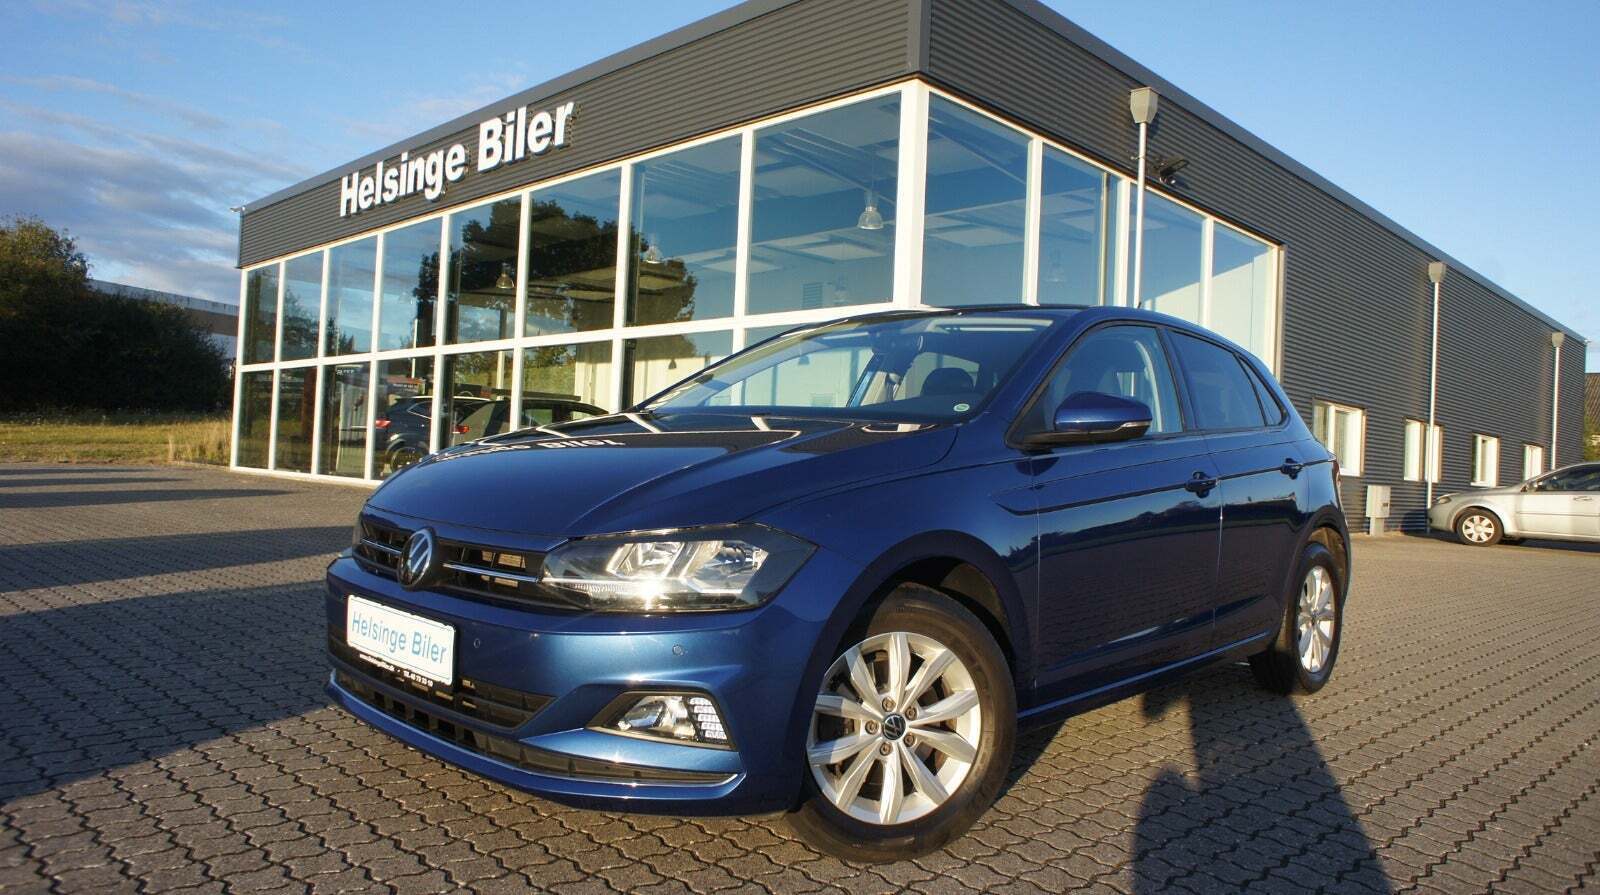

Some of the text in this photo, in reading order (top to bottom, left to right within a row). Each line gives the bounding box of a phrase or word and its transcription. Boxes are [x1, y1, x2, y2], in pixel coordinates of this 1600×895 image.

[339, 101, 576, 217] Helsinge Biler
[351, 611, 407, 654] Helsinge
[411, 631, 447, 664] Biler
